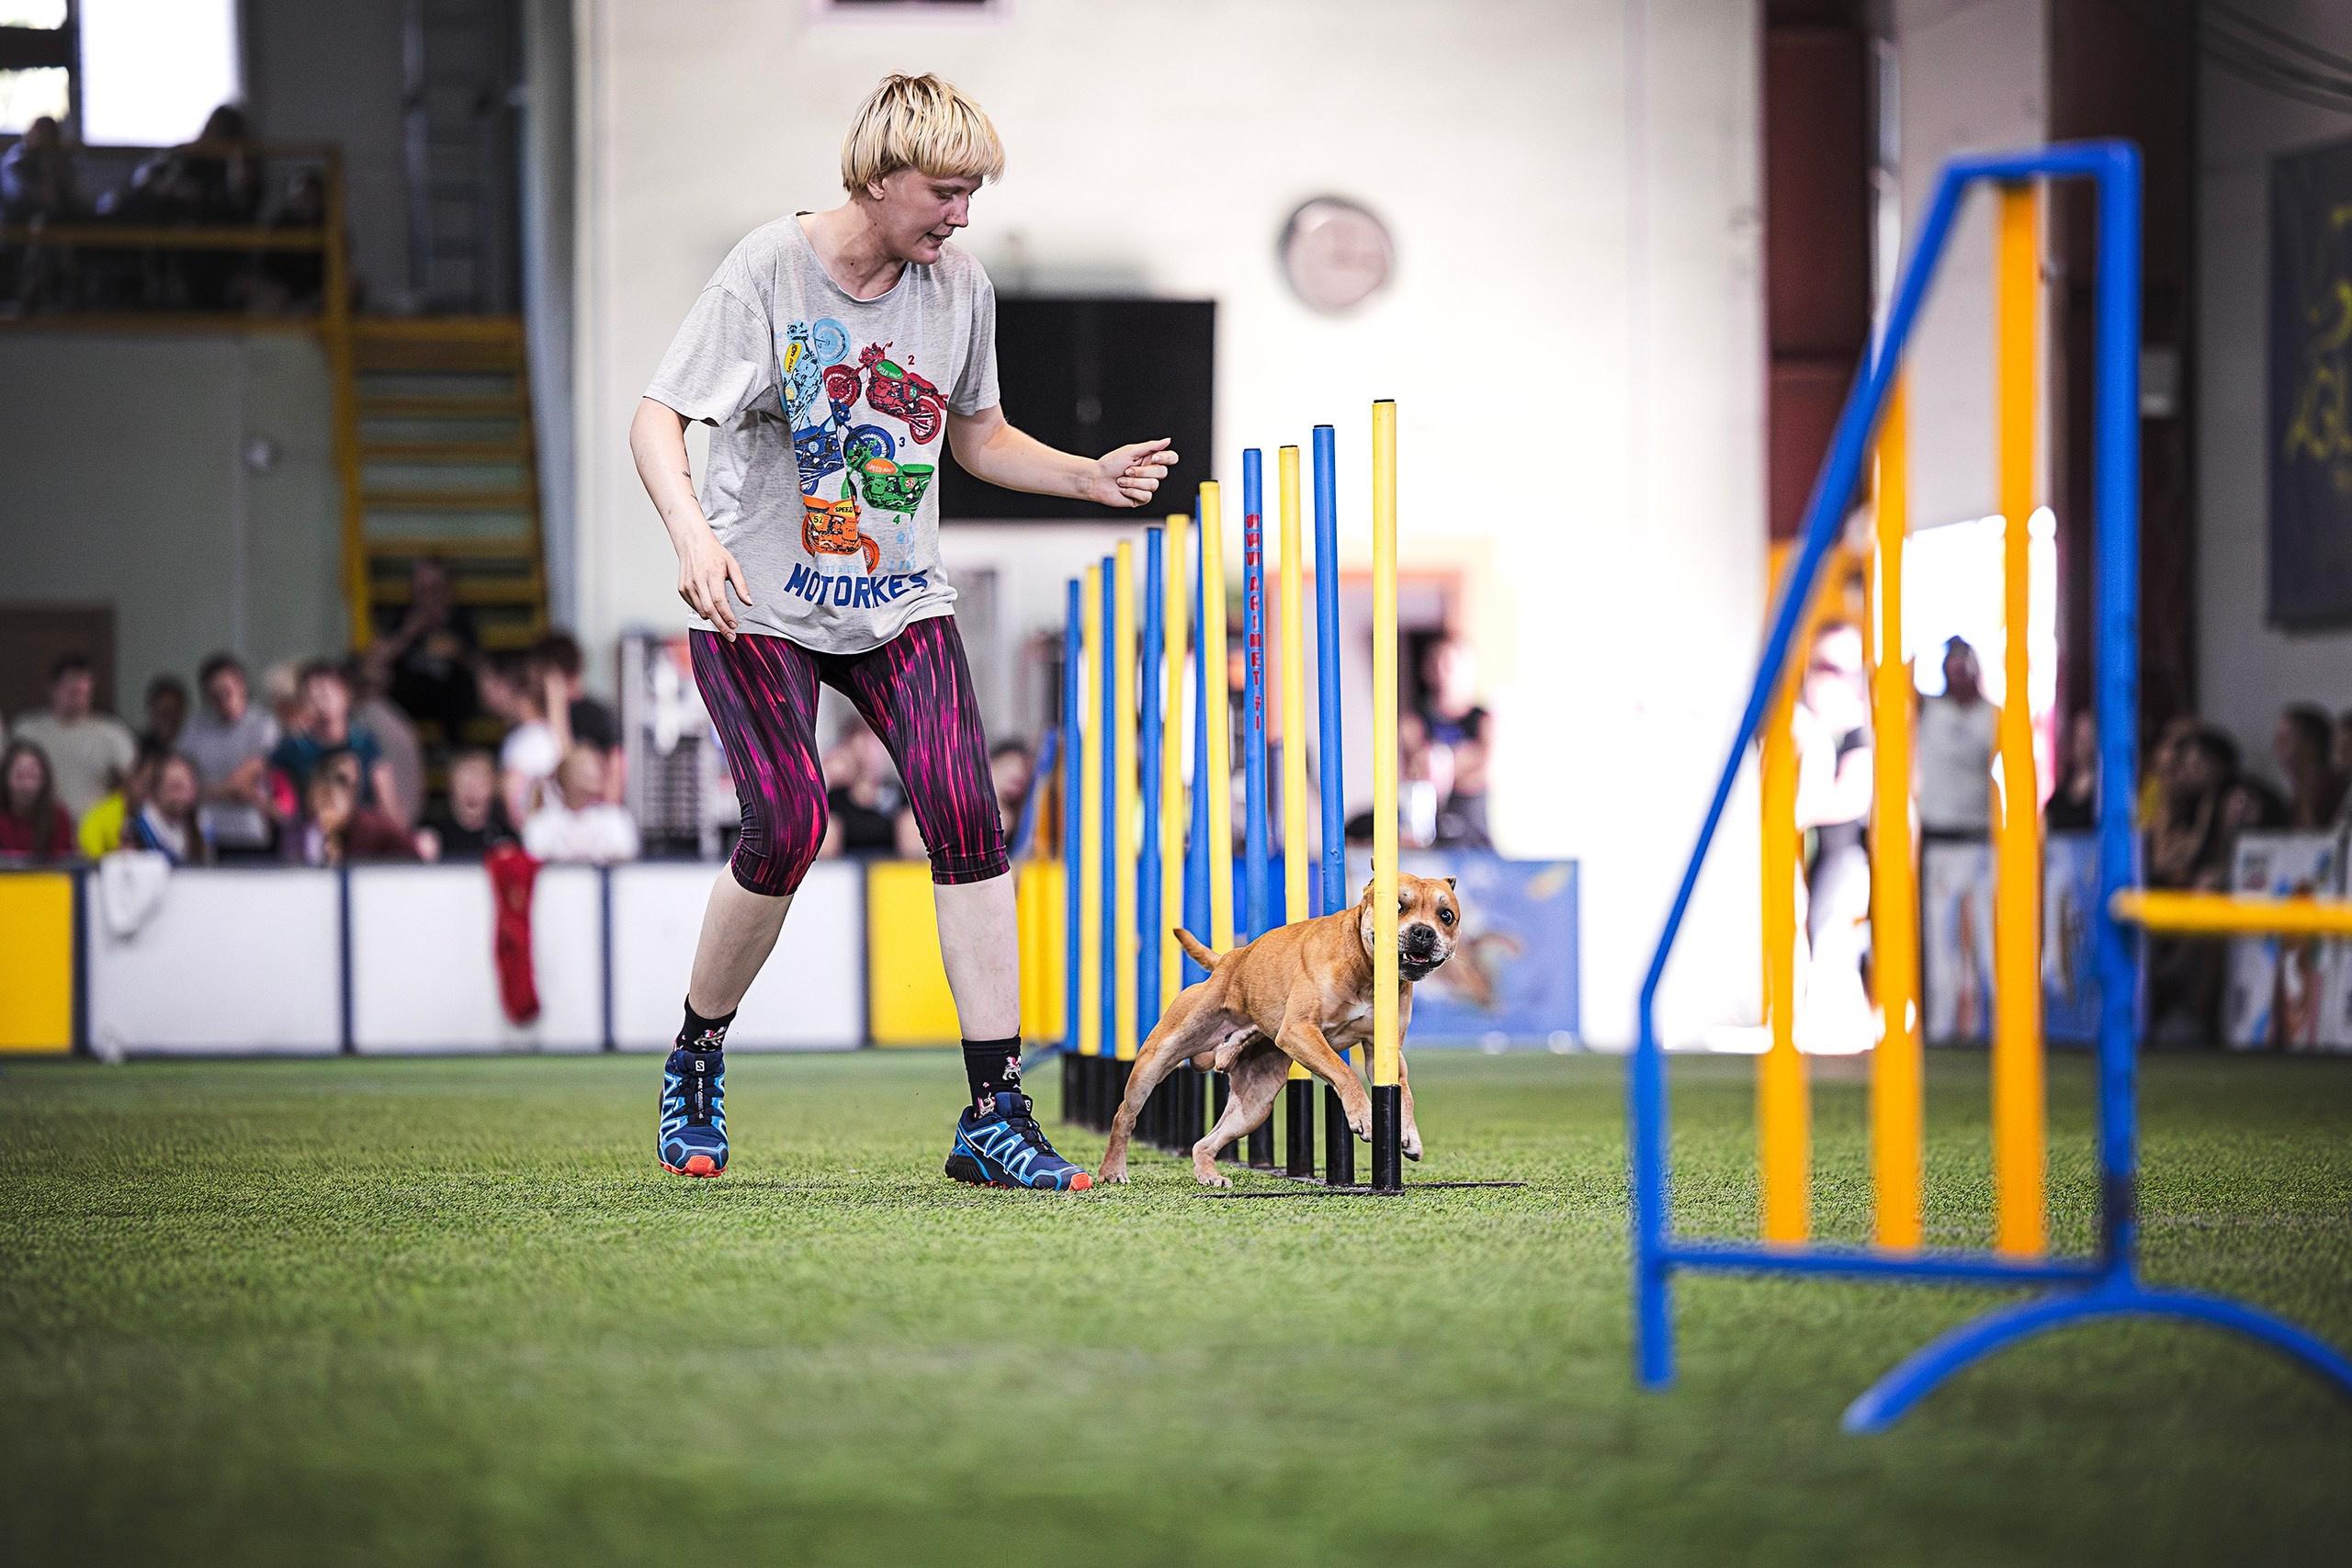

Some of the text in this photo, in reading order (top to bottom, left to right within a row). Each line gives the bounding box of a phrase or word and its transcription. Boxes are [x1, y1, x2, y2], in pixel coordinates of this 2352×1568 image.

[908, 355, 915, 366] 2
[899, 436, 906, 448] 3
[813, 515, 823, 525] 52
[892, 514, 901, 525] 4
[784, 562, 928, 609] MOTORKES
